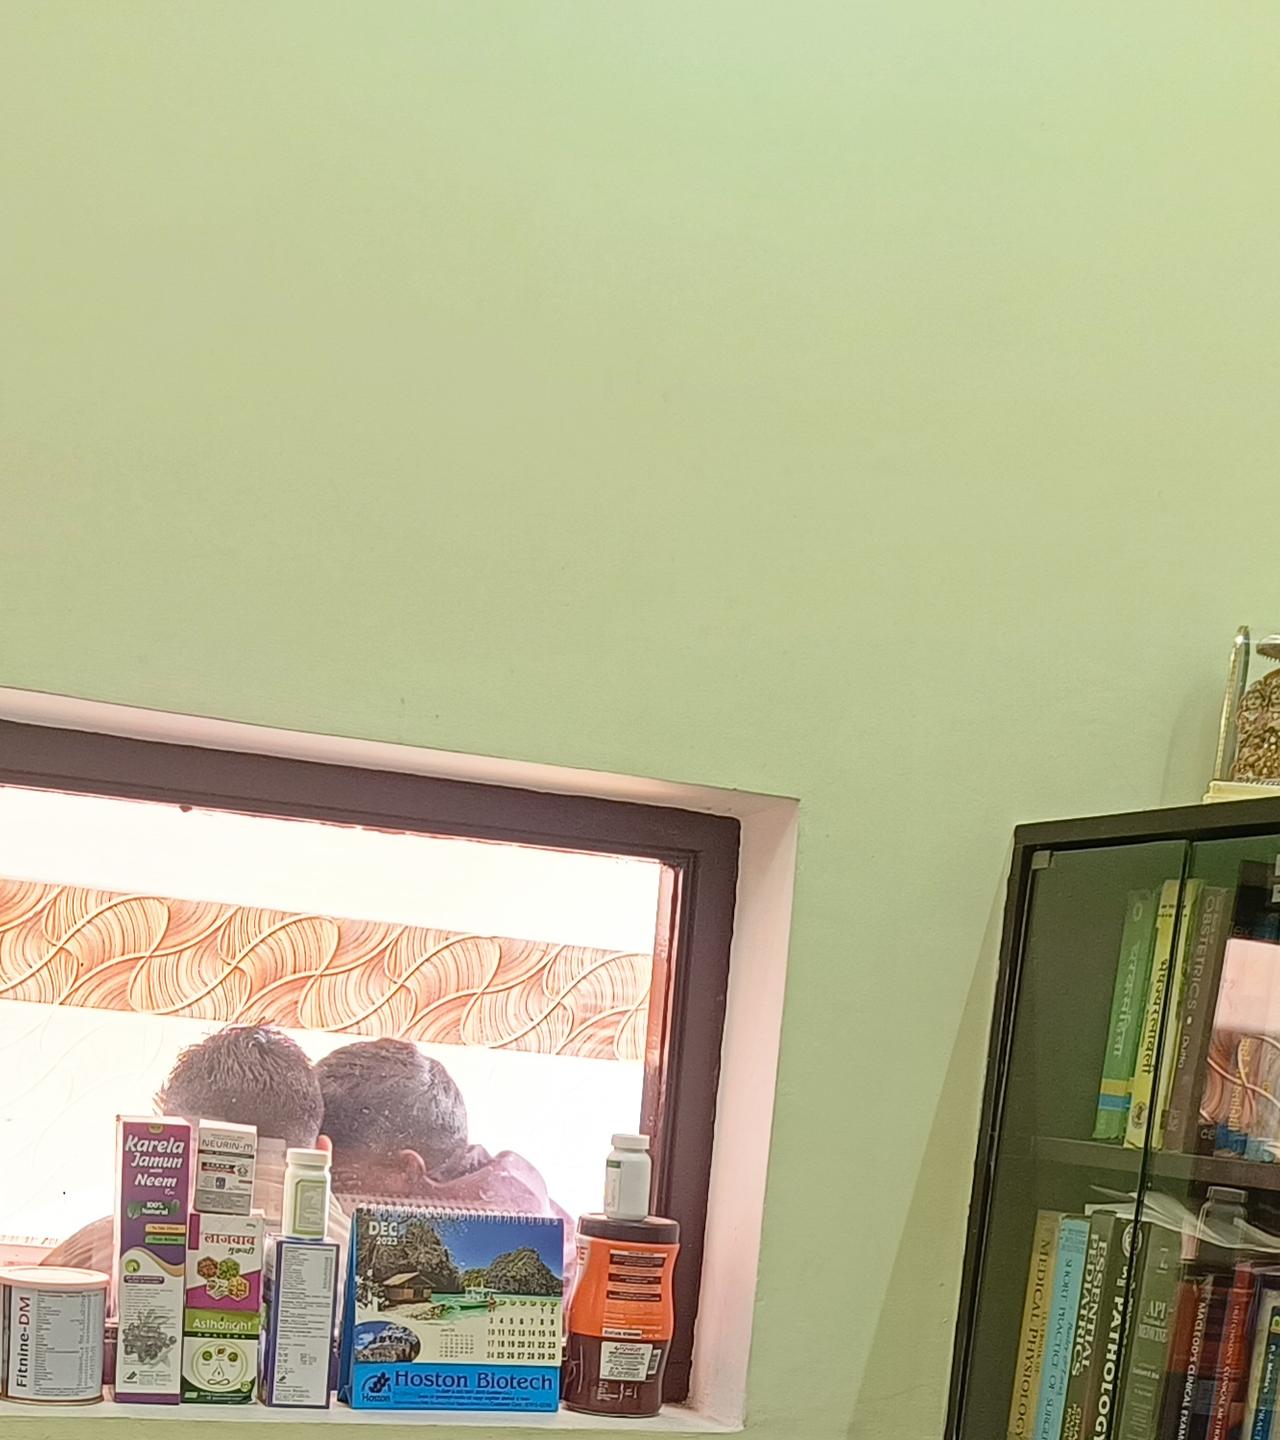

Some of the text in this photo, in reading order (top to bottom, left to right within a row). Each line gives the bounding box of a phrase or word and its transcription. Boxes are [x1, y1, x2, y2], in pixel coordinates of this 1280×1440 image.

[1185, 895, 1216, 1011] OBSTETRICS
[126, 1135, 185, 1154] Karela
[130, 1153, 183, 1169] Jamun
[134, 1174, 177, 1188] Neem
[142, 1206, 169, 1216] Natural
[146, 1201, 163, 1209] 100%
[369, 1221, 399, 1237] DEC
[376, 1237, 398, 1246] 2023
[1071, 1233, 1100, 1376] PEDIATRICS
[1082, 1240, 1108, 1372] ESSENTIAL
[508, 1329, 515, 1337] 12
[518, 1329, 525, 1337] 13
[548, 1330, 556, 1338] 16
[1015, 1239, 1049, 1438] MEDICAL PHYSIOLOGY
[1048, 1306, 1065, 1372] PRACTICE
[1188, 1303, 1206, 1361] MACLEOD'S
[16, 1296, 31, 1388] Fitnine-DM
[528, 1341, 536, 1349] 21
[508, 1352, 515, 1360] 26
[518, 1352, 525, 1360] 27
[528, 1352, 536, 1360] 28
[394, 1370, 553, 1391] Hoston Biotech
[1181, 1365, 1196, 1406] CLINICAL
[362, 1393, 391, 1402] Hoston
